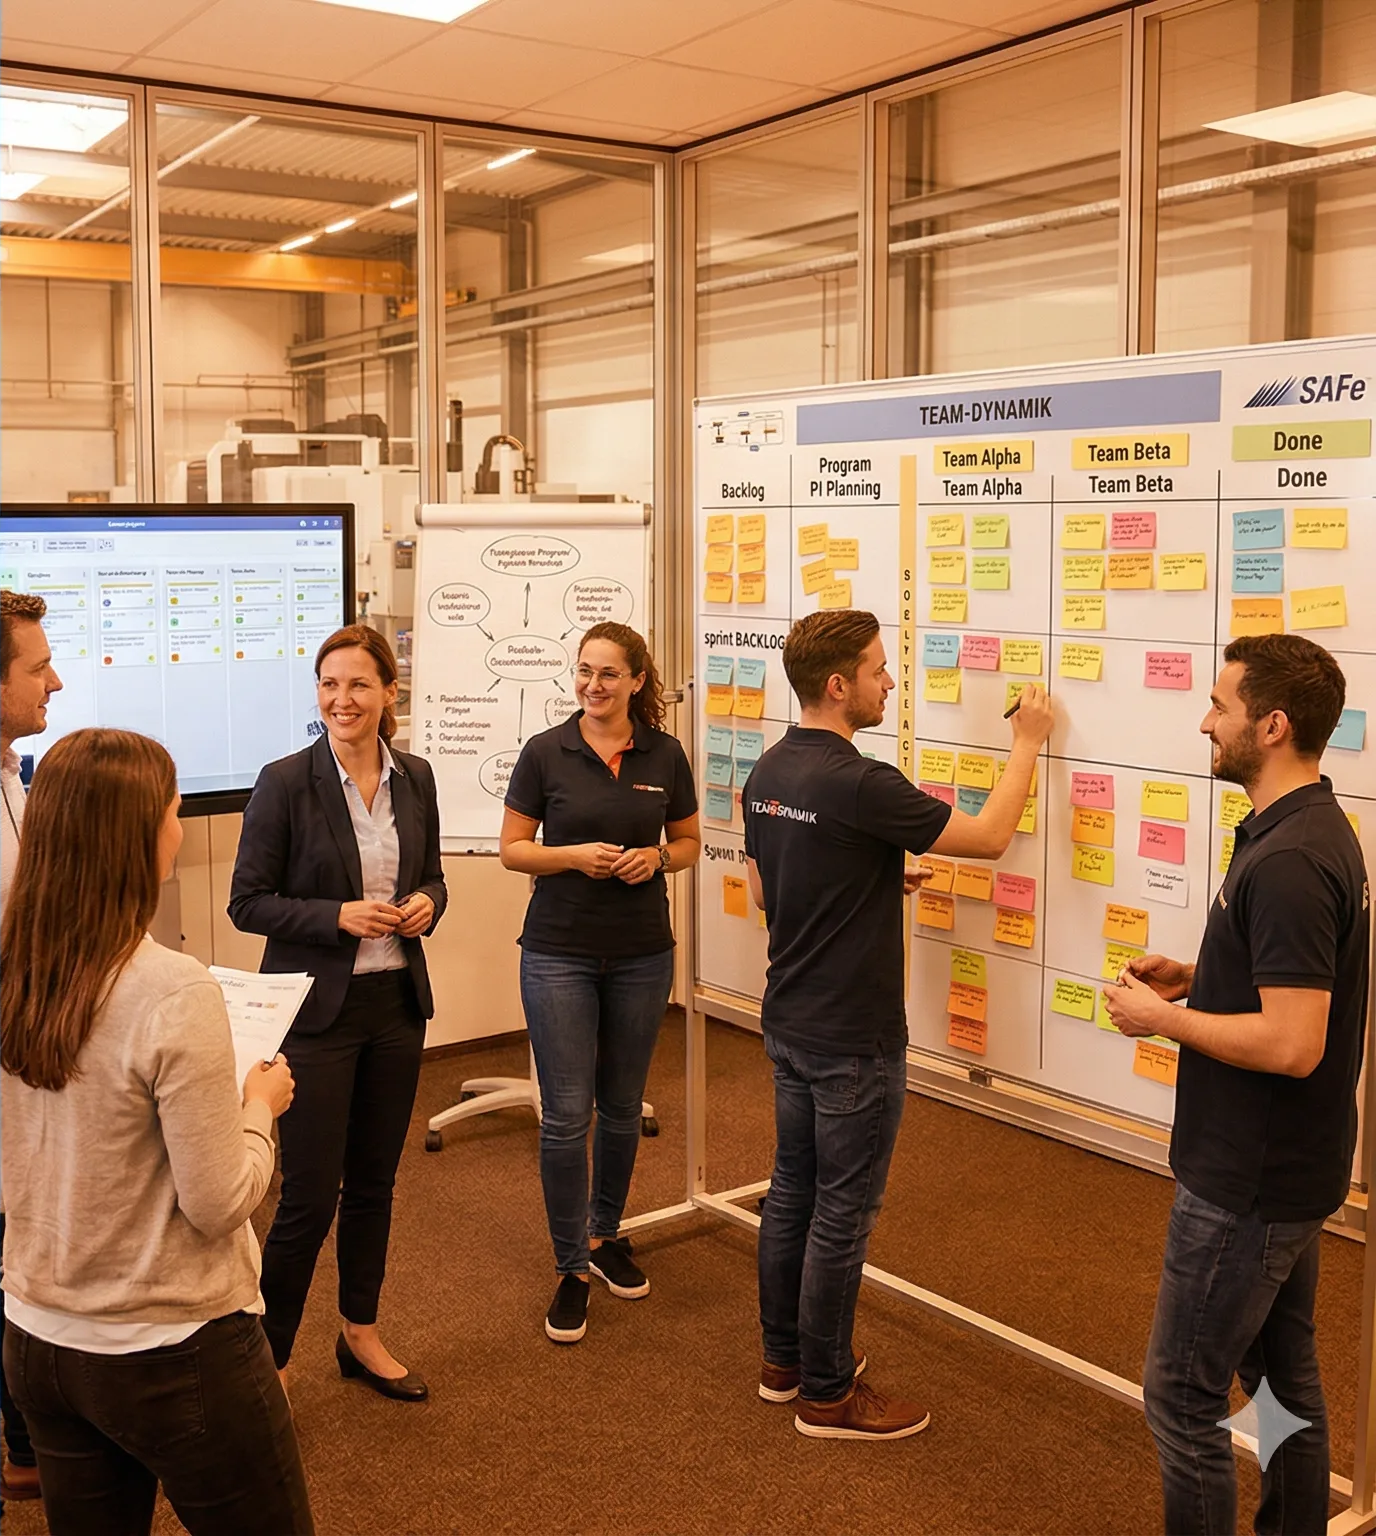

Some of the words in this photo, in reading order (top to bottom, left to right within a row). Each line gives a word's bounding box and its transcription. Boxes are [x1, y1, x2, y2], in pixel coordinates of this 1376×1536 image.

[1299, 374, 1366, 405] SAFe
[920, 397, 1052, 425] TEAM-DYNAMIK
[1087, 444, 1129, 462] Team
[1134, 442, 1171, 461] Beta
[1274, 431, 1323, 452] Done
[819, 457, 872, 477] Program
[943, 451, 978, 468] Team
[981, 447, 1021, 470] Alpha
[1088, 475, 1131, 494] Team
[1136, 474, 1173, 493] Beta
[1277, 467, 1328, 488] Done
[721, 482, 765, 501] Backlog
[810, 481, 822, 497] PI
[827, 479, 881, 500] Planning
[943, 480, 978, 497] Team
[982, 477, 1022, 500] Alpha
[704, 630, 733, 648] sprint
[736, 632, 785, 650] BACKLOG
